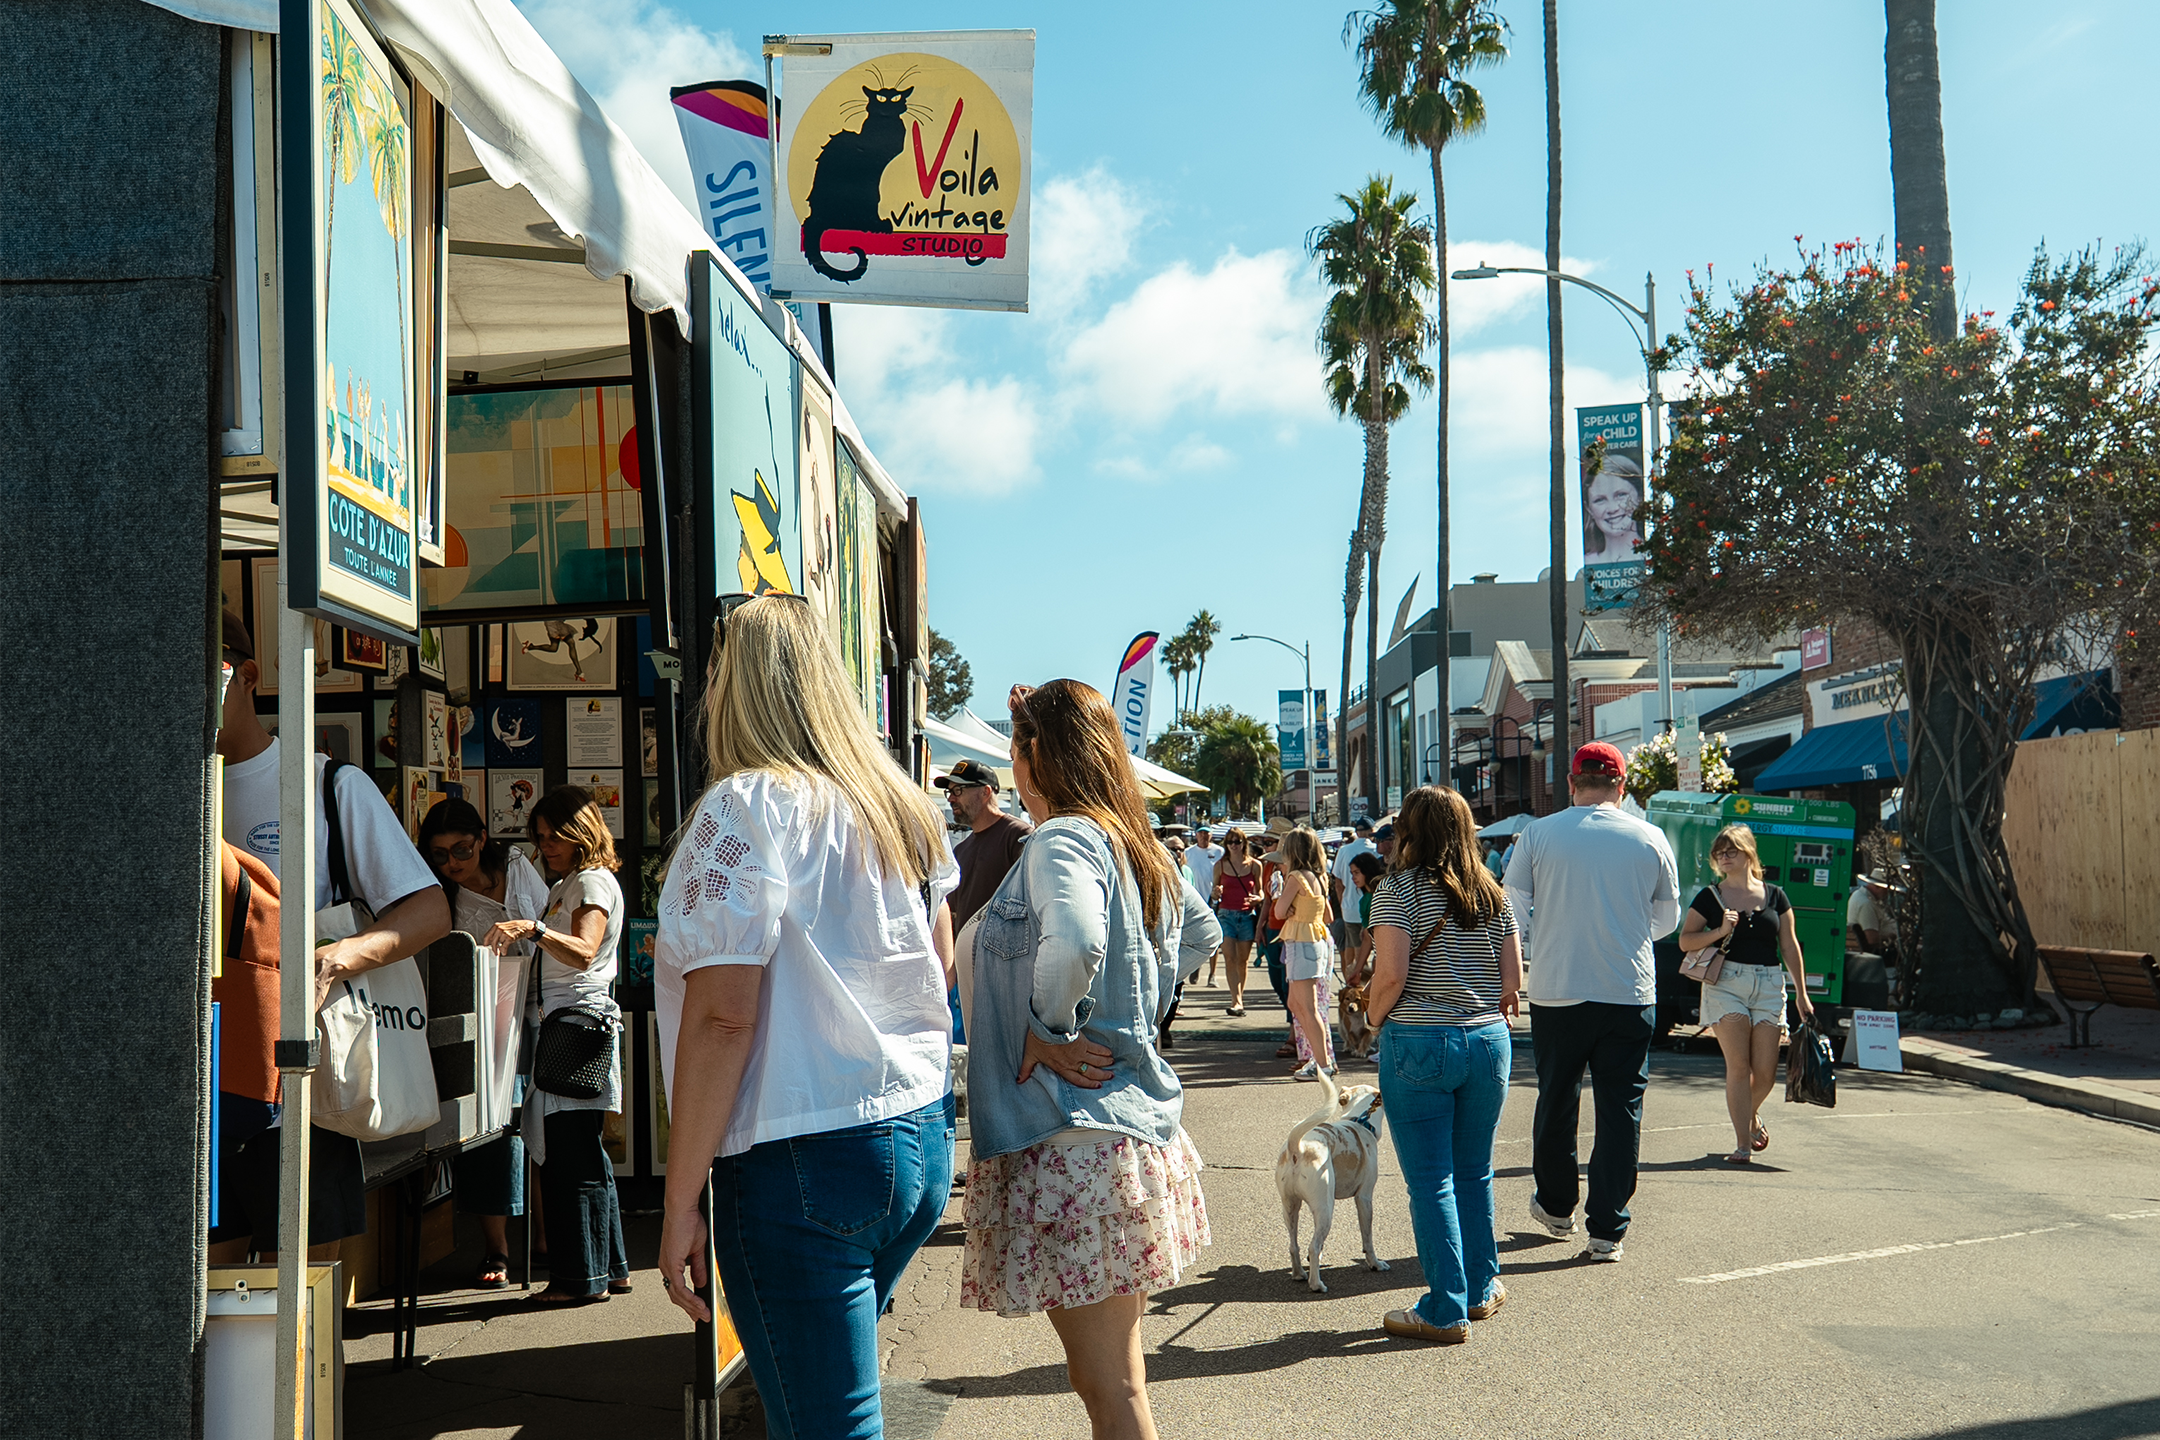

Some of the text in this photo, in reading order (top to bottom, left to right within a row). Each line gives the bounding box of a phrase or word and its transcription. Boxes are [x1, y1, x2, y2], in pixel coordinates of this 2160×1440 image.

[912, 97, 999, 199] Voila
[902, 236, 983, 254] STUDIO
[1583, 412, 1637, 427] SPEAK UP
[1602, 426, 1637, 439] CHILD
[1620, 440, 1638, 448] CARE
[369, 514, 408, 569] D'AZUR
[344, 547, 368, 574] TOUTE
[1831, 680, 1897, 710] MEANLEY
[1753, 802, 1795, 813] SUNBELT
[1867, 1014, 1896, 1023] PARKING
